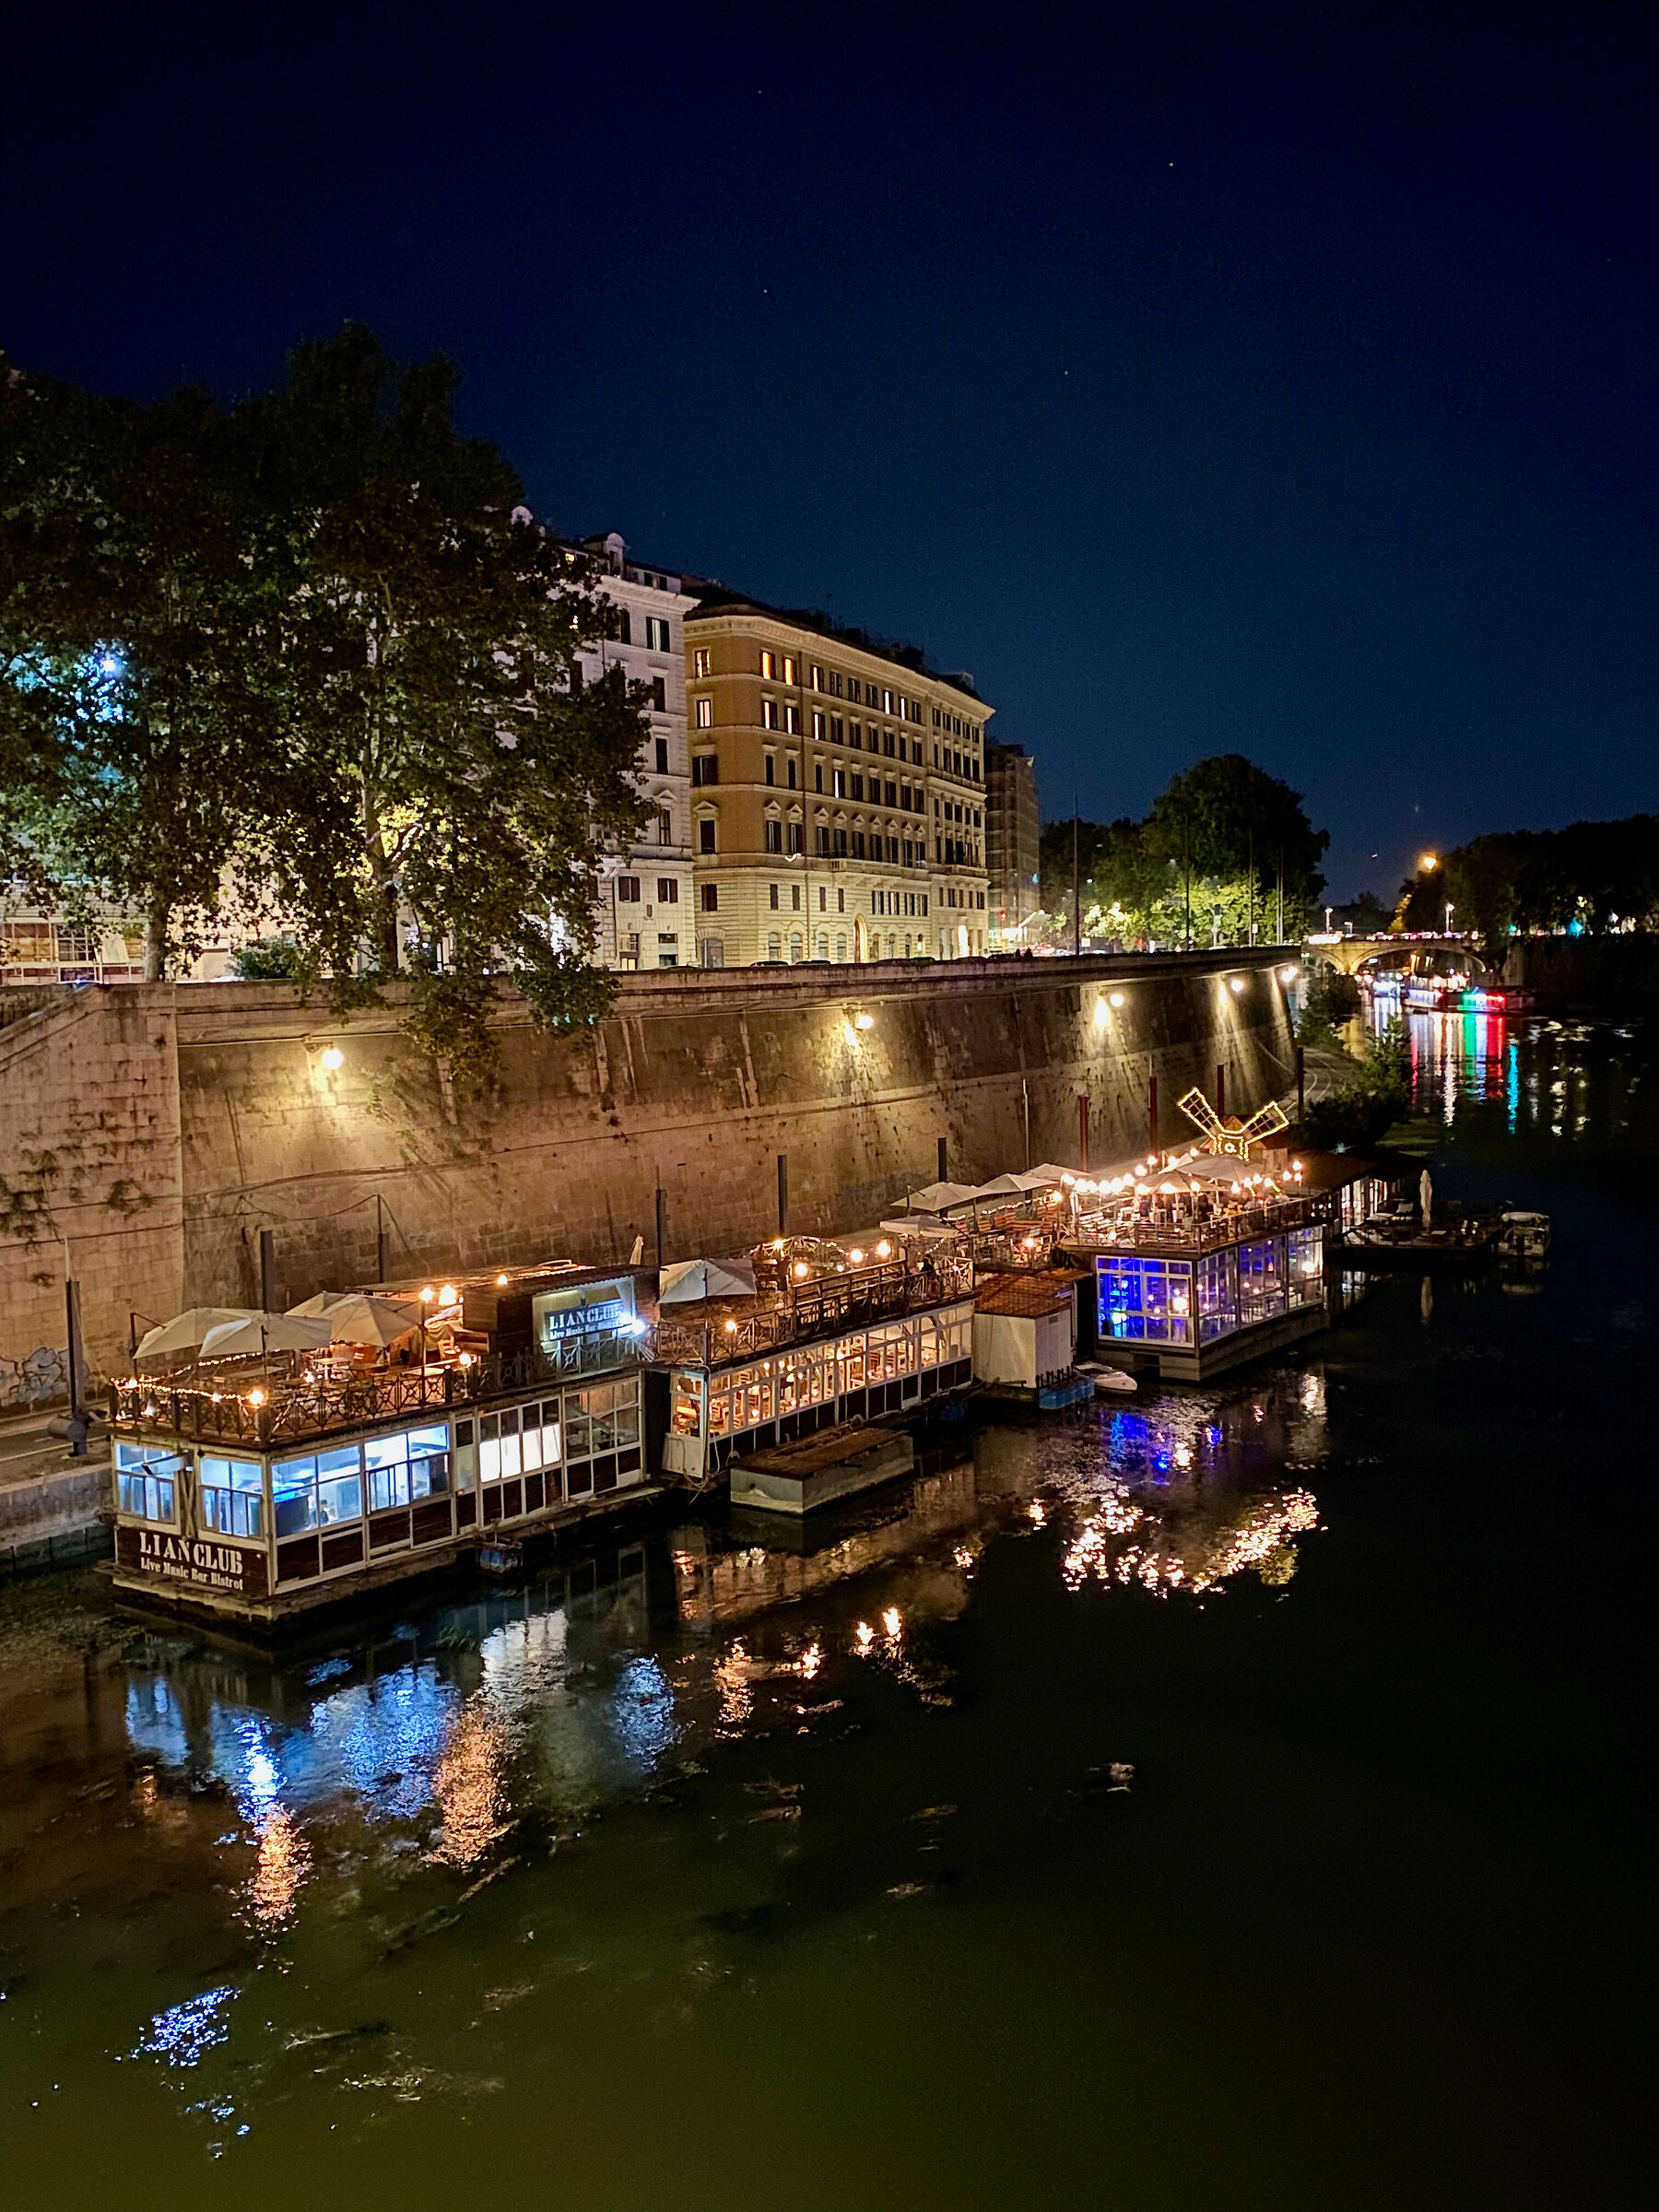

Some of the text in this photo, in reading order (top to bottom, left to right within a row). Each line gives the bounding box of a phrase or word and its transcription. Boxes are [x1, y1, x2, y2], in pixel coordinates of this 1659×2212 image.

[140, 1557, 243, 1592] Live Music Bar Bistrot
